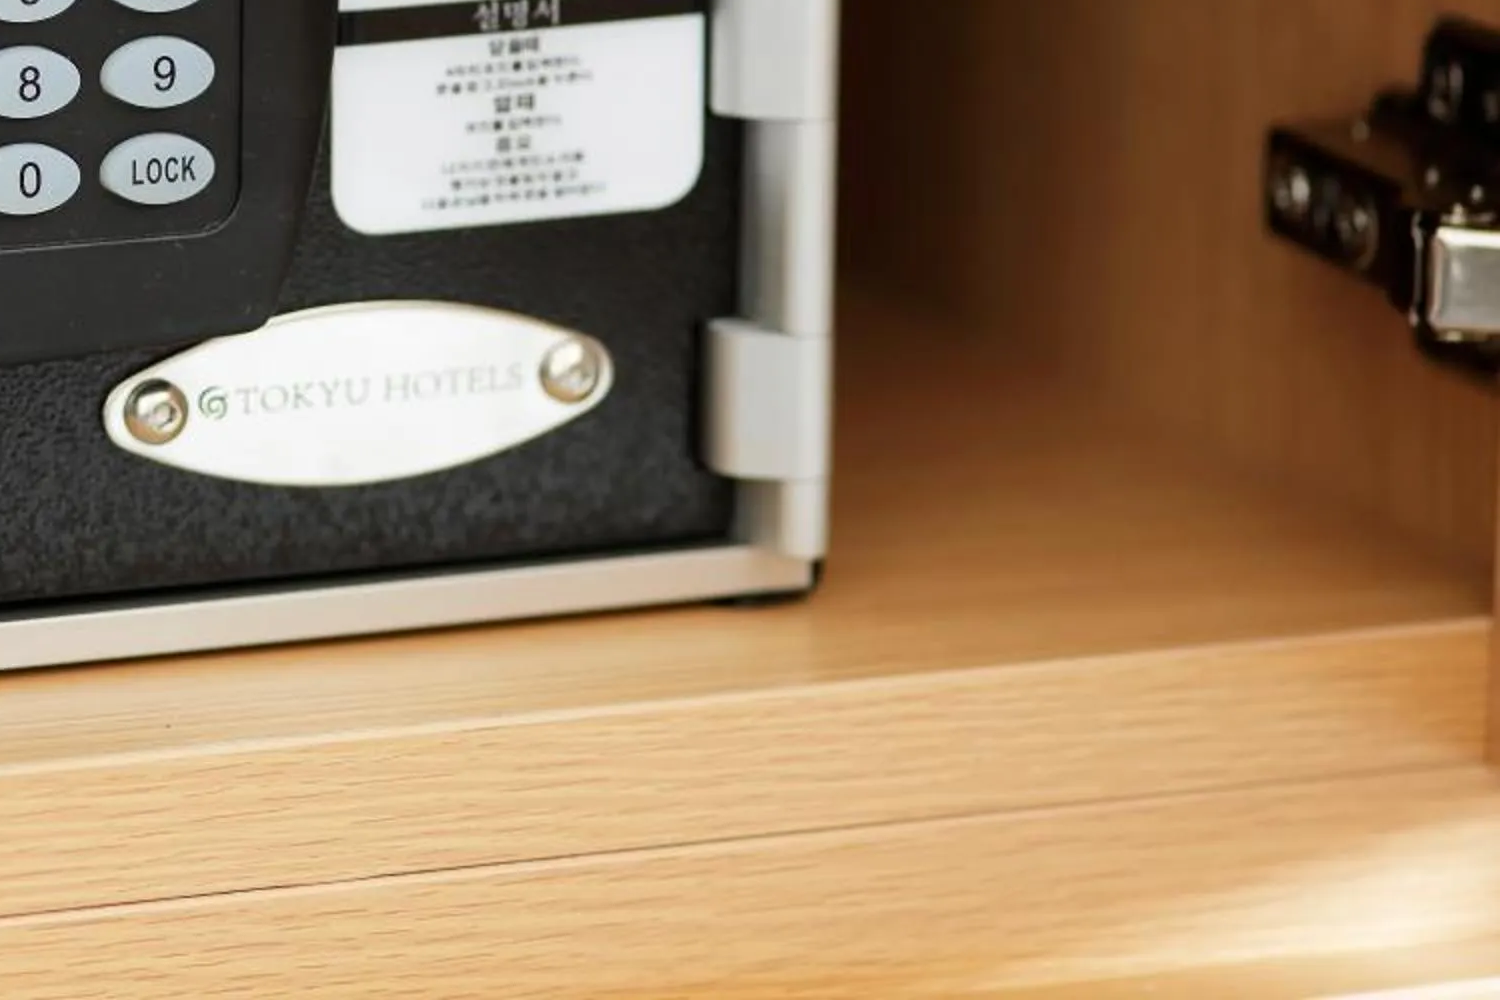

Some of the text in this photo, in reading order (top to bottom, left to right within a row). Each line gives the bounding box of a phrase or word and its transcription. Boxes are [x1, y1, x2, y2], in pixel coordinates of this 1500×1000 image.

[19, 66, 41, 102] 8
[153, 55, 176, 91] 9
[19, 162, 41, 198] 0
[132, 155, 196, 185] LOCK
[235, 362, 526, 416] TOKYU HOTELS
